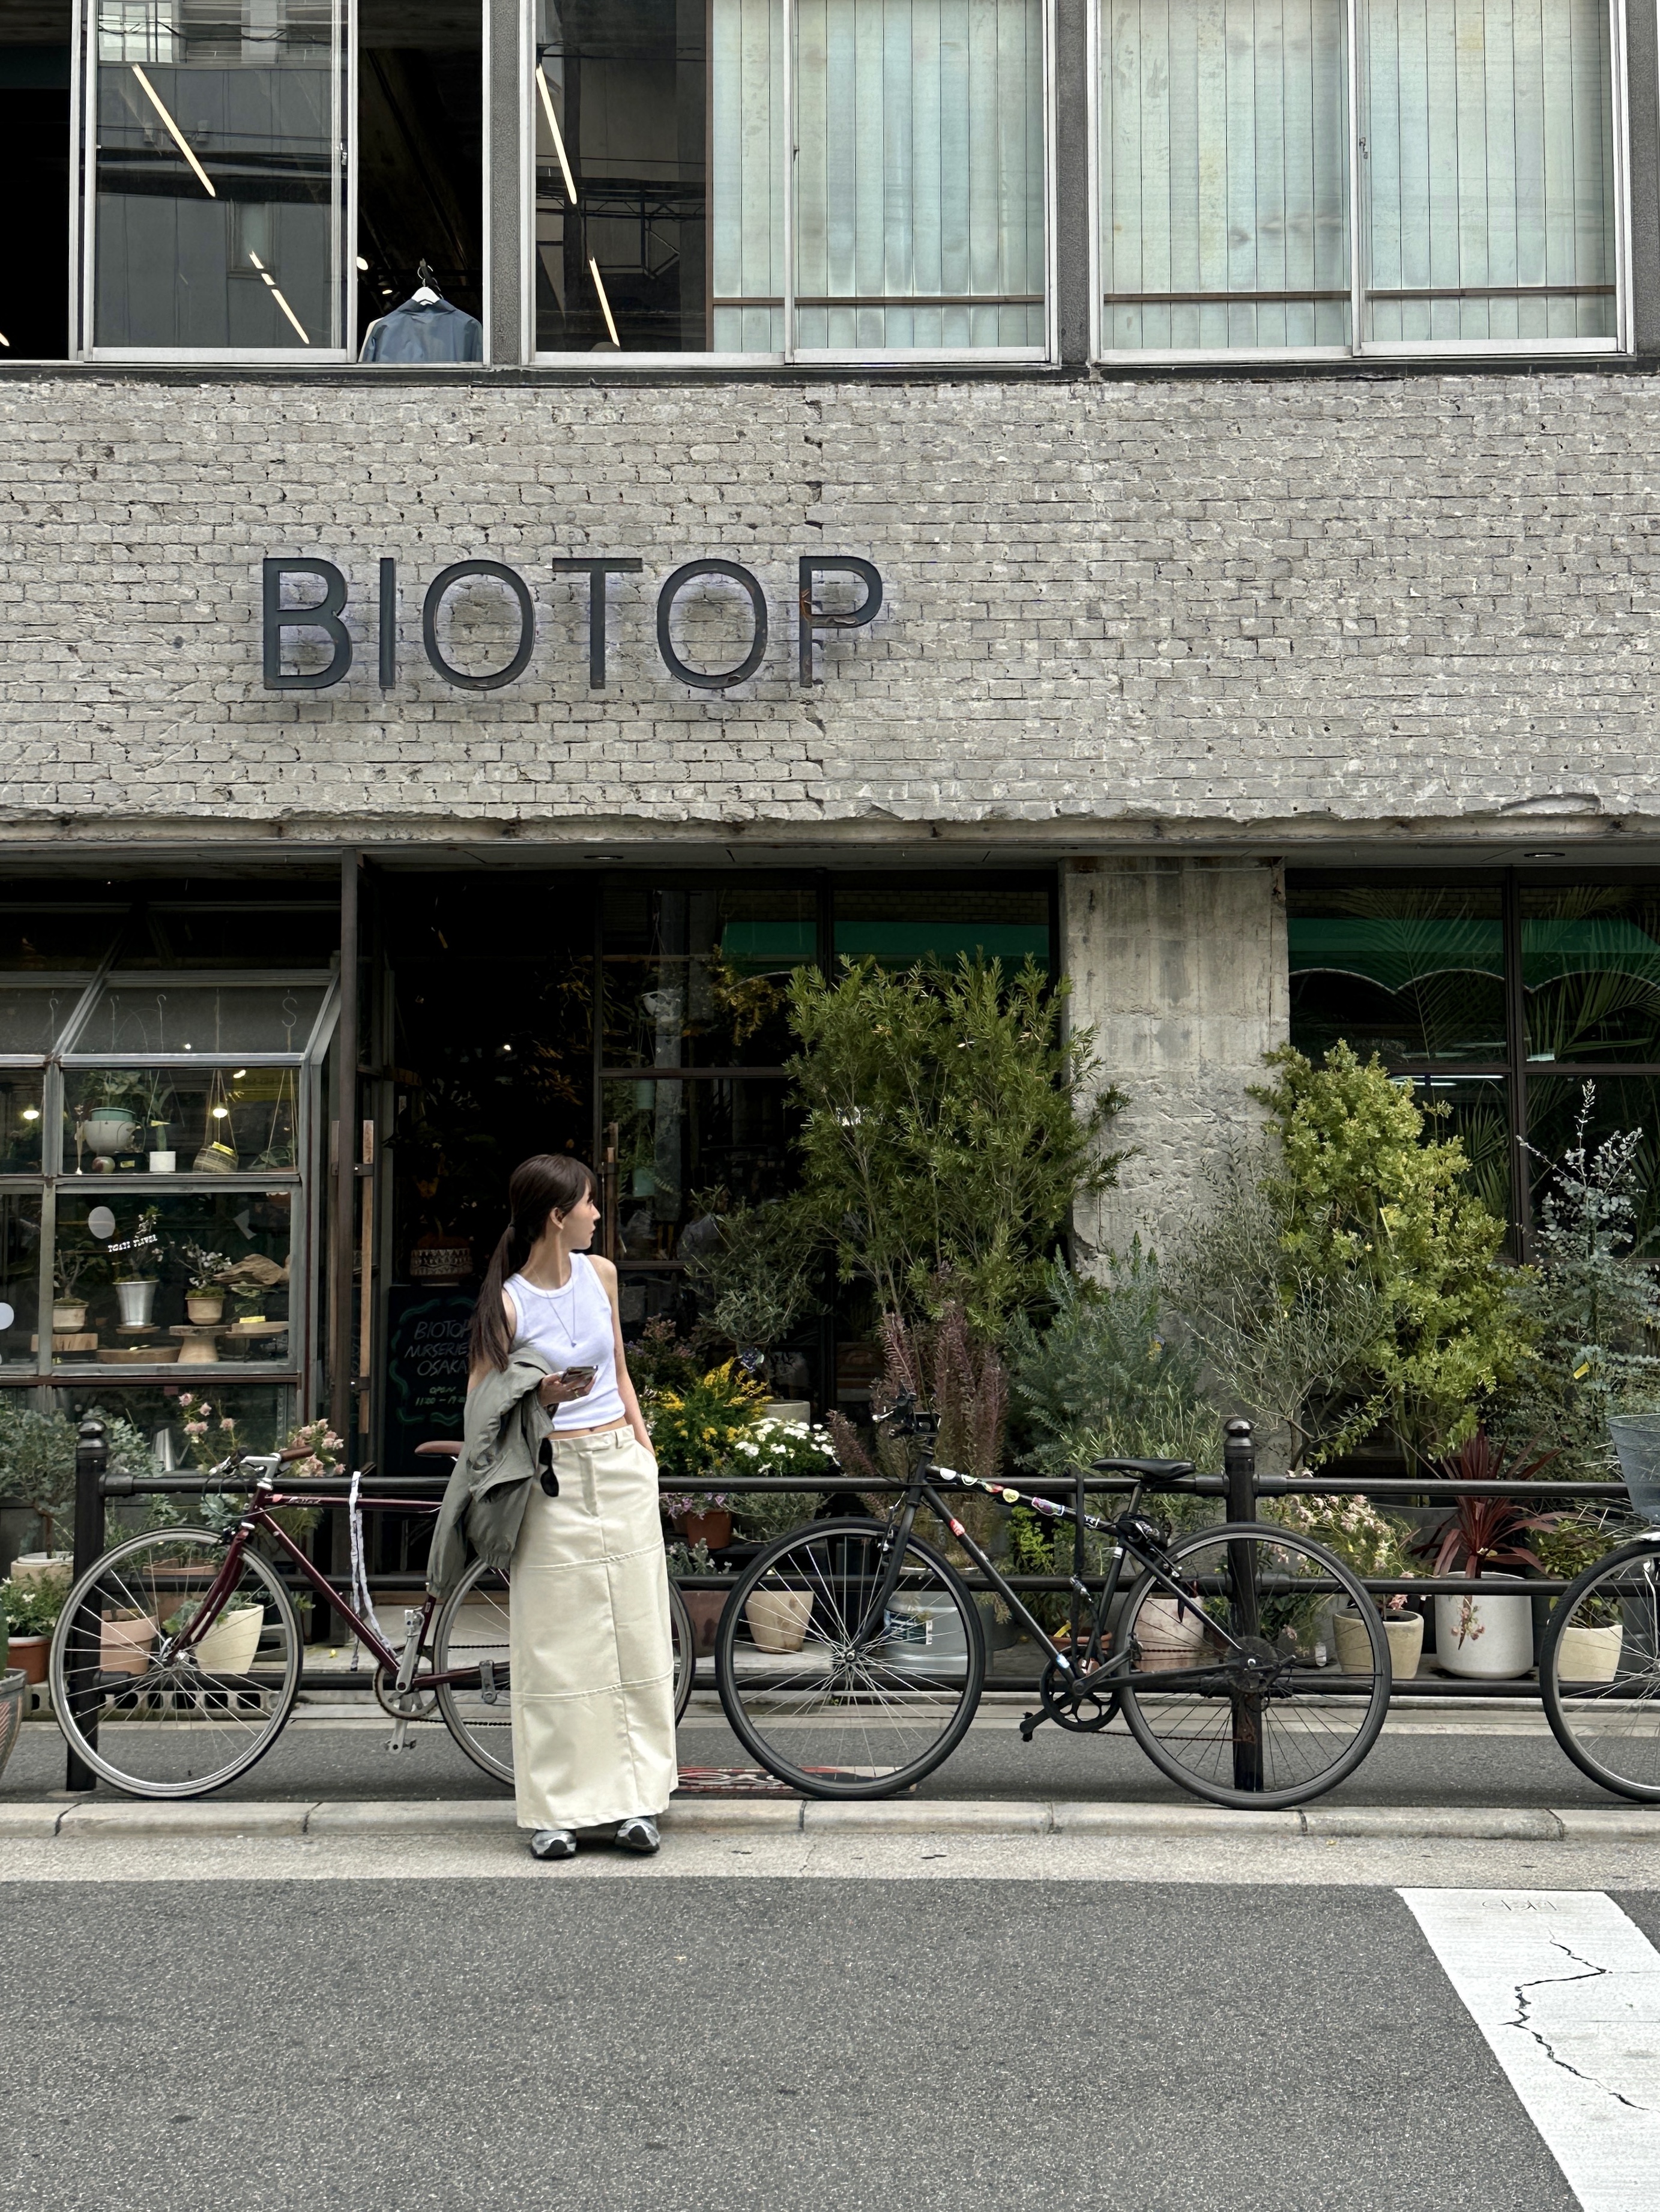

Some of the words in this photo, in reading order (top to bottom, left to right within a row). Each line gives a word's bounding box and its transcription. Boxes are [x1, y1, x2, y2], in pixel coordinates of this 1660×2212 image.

[262, 555, 883, 689] BIOTOP
[405, 1343, 469, 1358] NURSERIE
[417, 1360, 468, 1376] OSAKA
